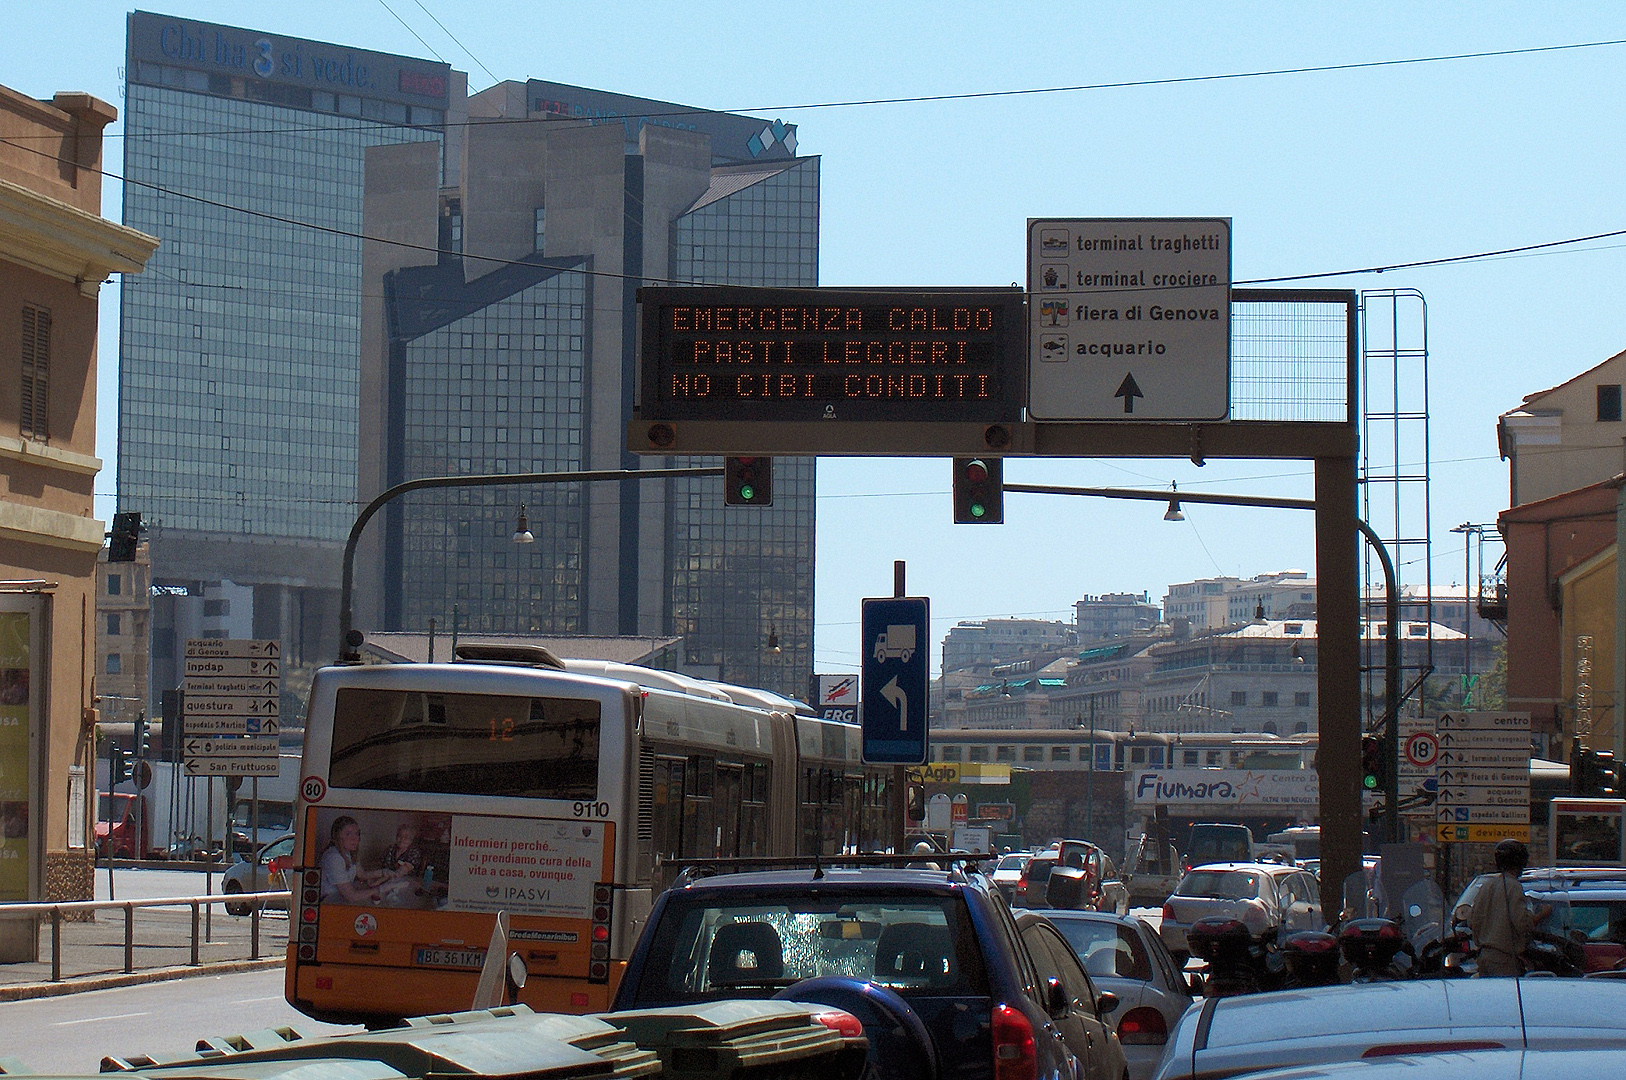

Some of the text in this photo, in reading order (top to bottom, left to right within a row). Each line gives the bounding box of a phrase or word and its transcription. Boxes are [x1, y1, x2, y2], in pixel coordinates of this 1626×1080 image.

[161, 24, 205, 63] Chi
[215, 32, 247, 69] ha
[252, 38, 275, 78] 3
[282, 45, 302, 78] si
[312, 55, 378, 90] vede.
[1077, 235, 1220, 254] terminal traghetti
[1077, 270, 1218, 286] terminal crociere
[673, 308, 993, 331] EMERGENZA CALDO
[1076, 305, 1220, 321] fiera di Genova
[694, 341, 967, 364] PASTI LEGGERI
[1076, 340, 1167, 357] acquario
[672, 374, 988, 397] NO CIBI CONDITI
[187, 640, 224, 648] acquario
[187, 648, 197, 656] di
[187, 662, 224, 673] inpdap
[187, 701, 234, 711] questura
[1494, 717, 1529, 725] centro
[489, 718, 515, 742] 12
[1412, 742, 1429, 758] 18
[209, 763, 277, 771] San Fruttuoso
[924, 765, 956, 781] Agip
[1272, 775, 1307, 783] Centro
[305, 783, 321, 797] 80
[1487, 789, 1521, 797] acquario
[573, 802, 609, 818] 9110
[1476, 828, 1529, 837] deviazione
[454, 836, 508, 848] Infermieri
[469, 853, 592, 868] ci prendiamo cura della
[468, 865, 576, 882] vita a casa, ovunque.
[505, 887, 551, 901] IPASVI
[425, 951, 440, 964] BG
